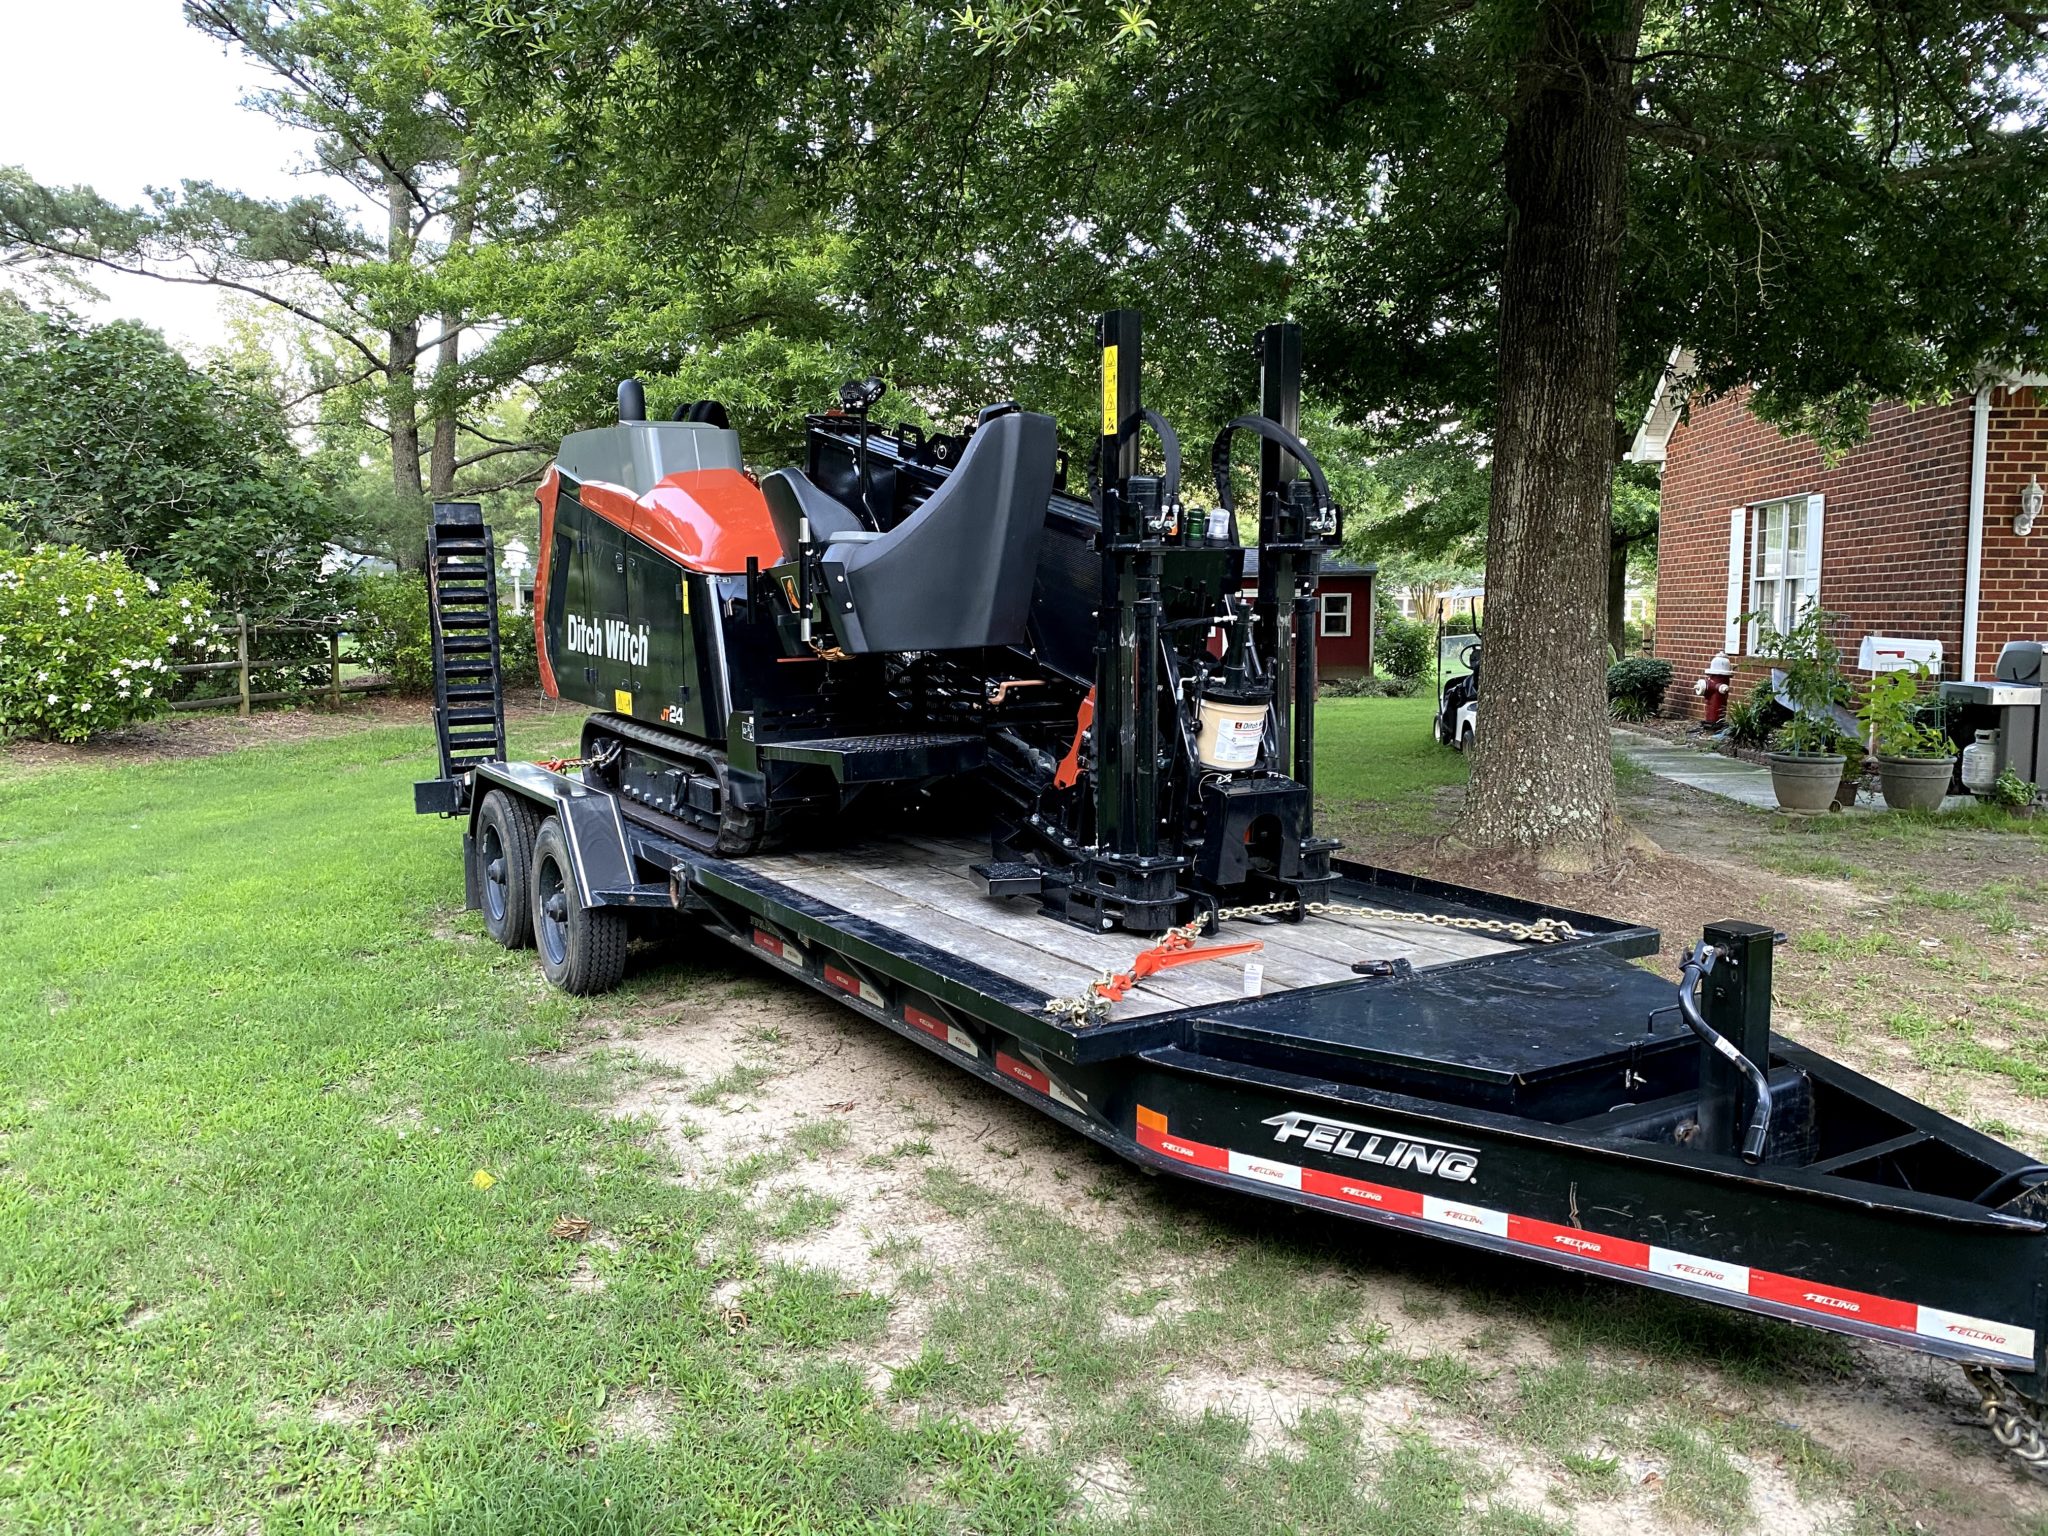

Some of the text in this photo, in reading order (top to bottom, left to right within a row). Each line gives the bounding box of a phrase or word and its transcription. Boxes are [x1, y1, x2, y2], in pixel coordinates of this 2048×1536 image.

[567, 613, 649, 667] Ditch Witch
[660, 705, 684, 725] JT24
[1161, 1141, 1195, 1157] FELLING
[1261, 1111, 1480, 1184] FELLING
[1247, 1164, 1285, 1179] FELLING
[1340, 1186, 1383, 1202] FELLING
[1553, 1235, 1602, 1252] FELLING
[1673, 1263, 1724, 1281] FELLING
[1802, 1293, 1860, 1313] FELLING
[1946, 1325, 2006, 1345] FELLING
